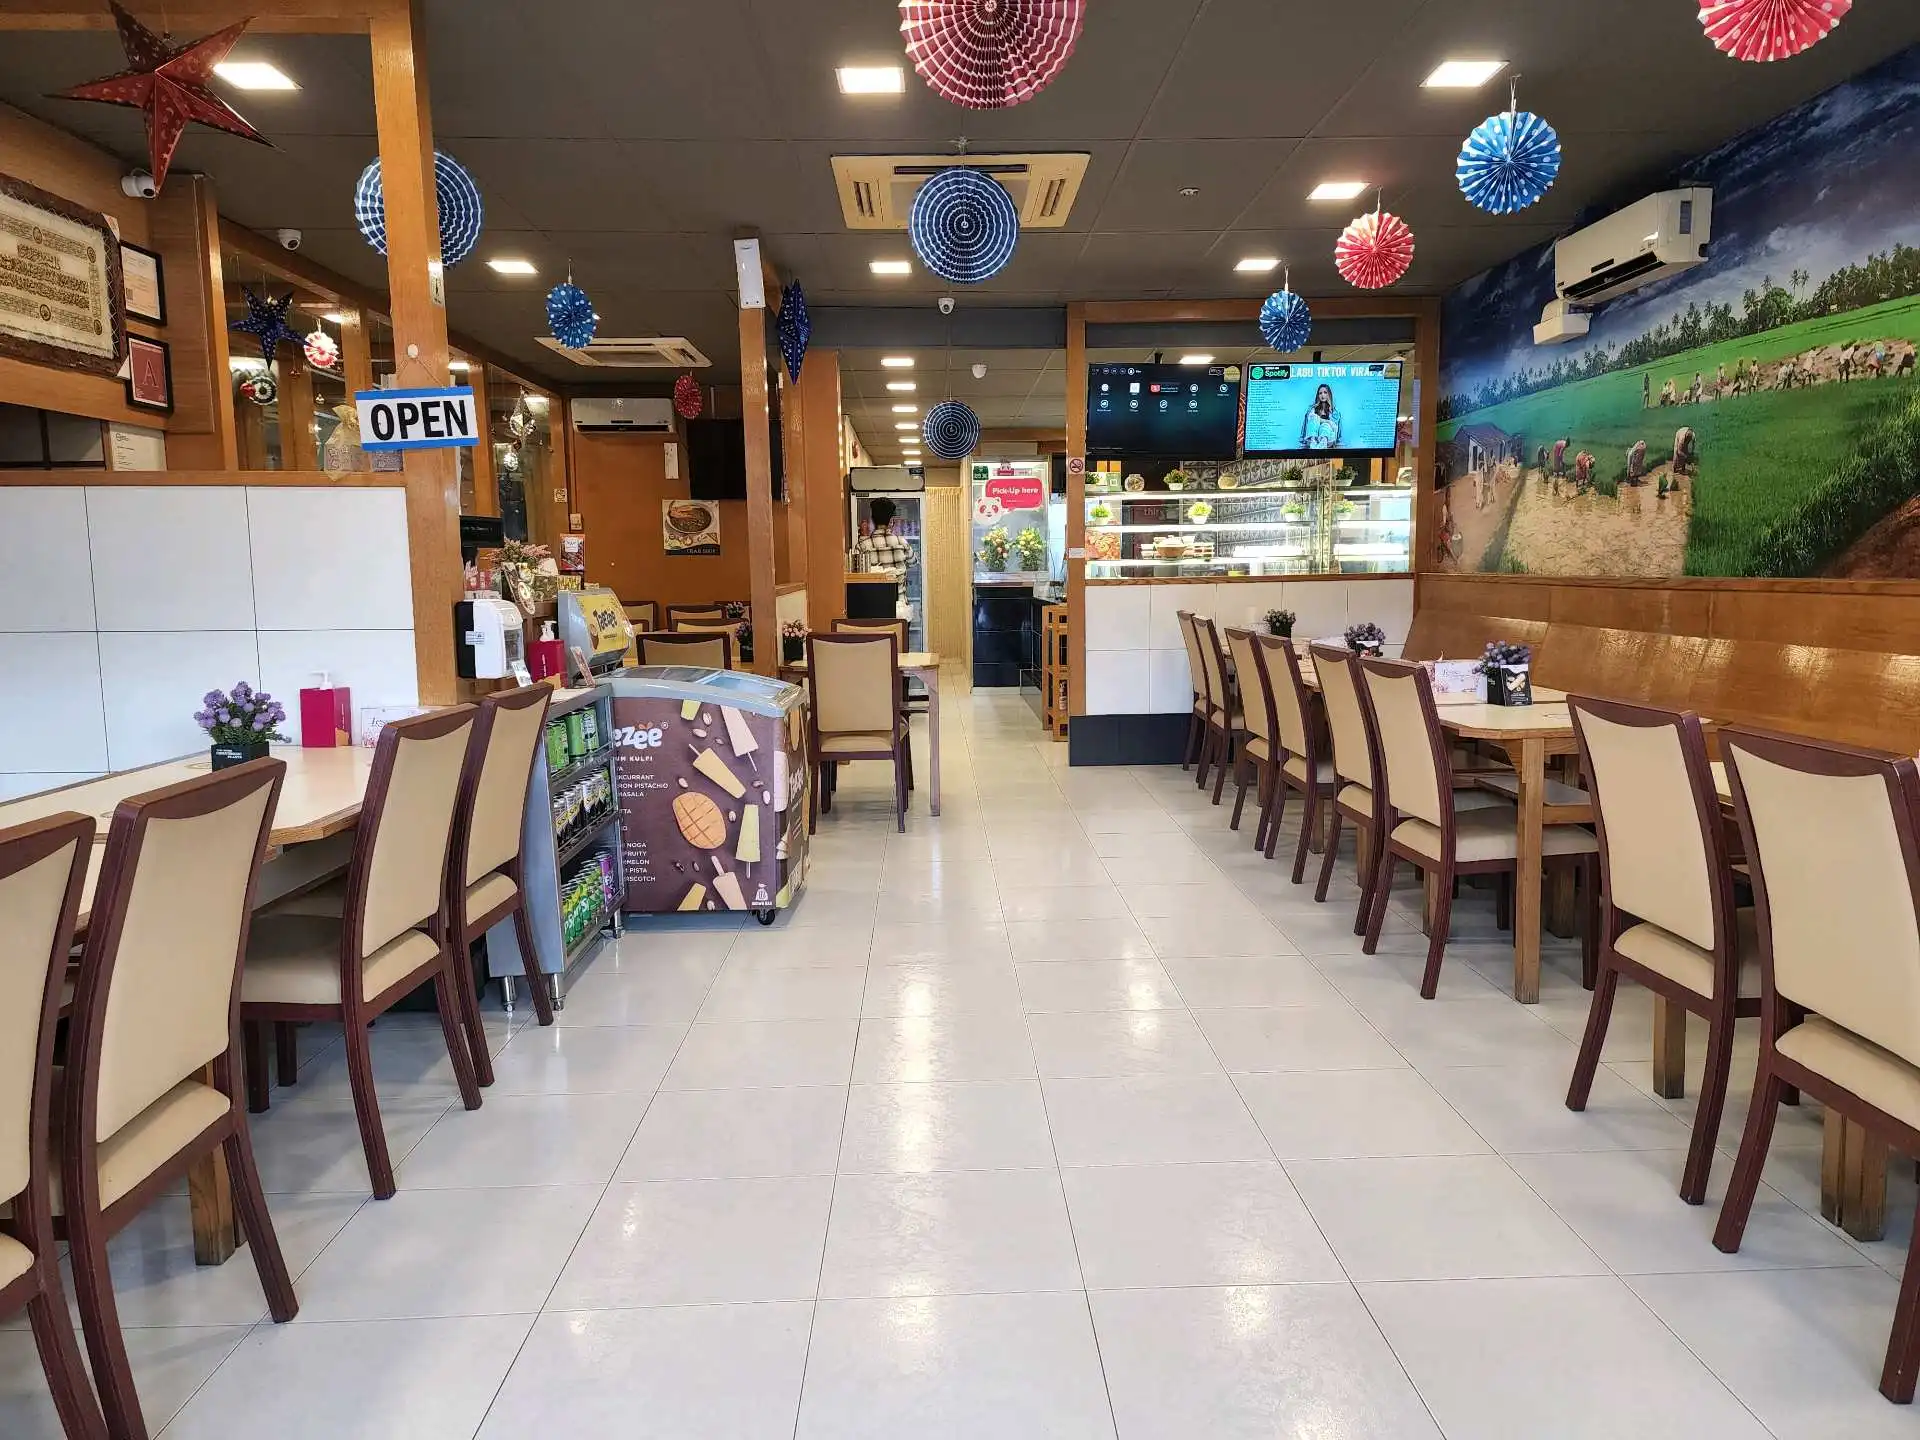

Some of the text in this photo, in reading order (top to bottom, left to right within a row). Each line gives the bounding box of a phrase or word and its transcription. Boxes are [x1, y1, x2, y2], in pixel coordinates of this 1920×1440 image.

[1264, 370, 1289, 379] Spotify
[1317, 366, 1347, 377] TIKTOK
[370, 399, 469, 441] OPEN
[992, 486, 1039, 496] Pick-Up here
